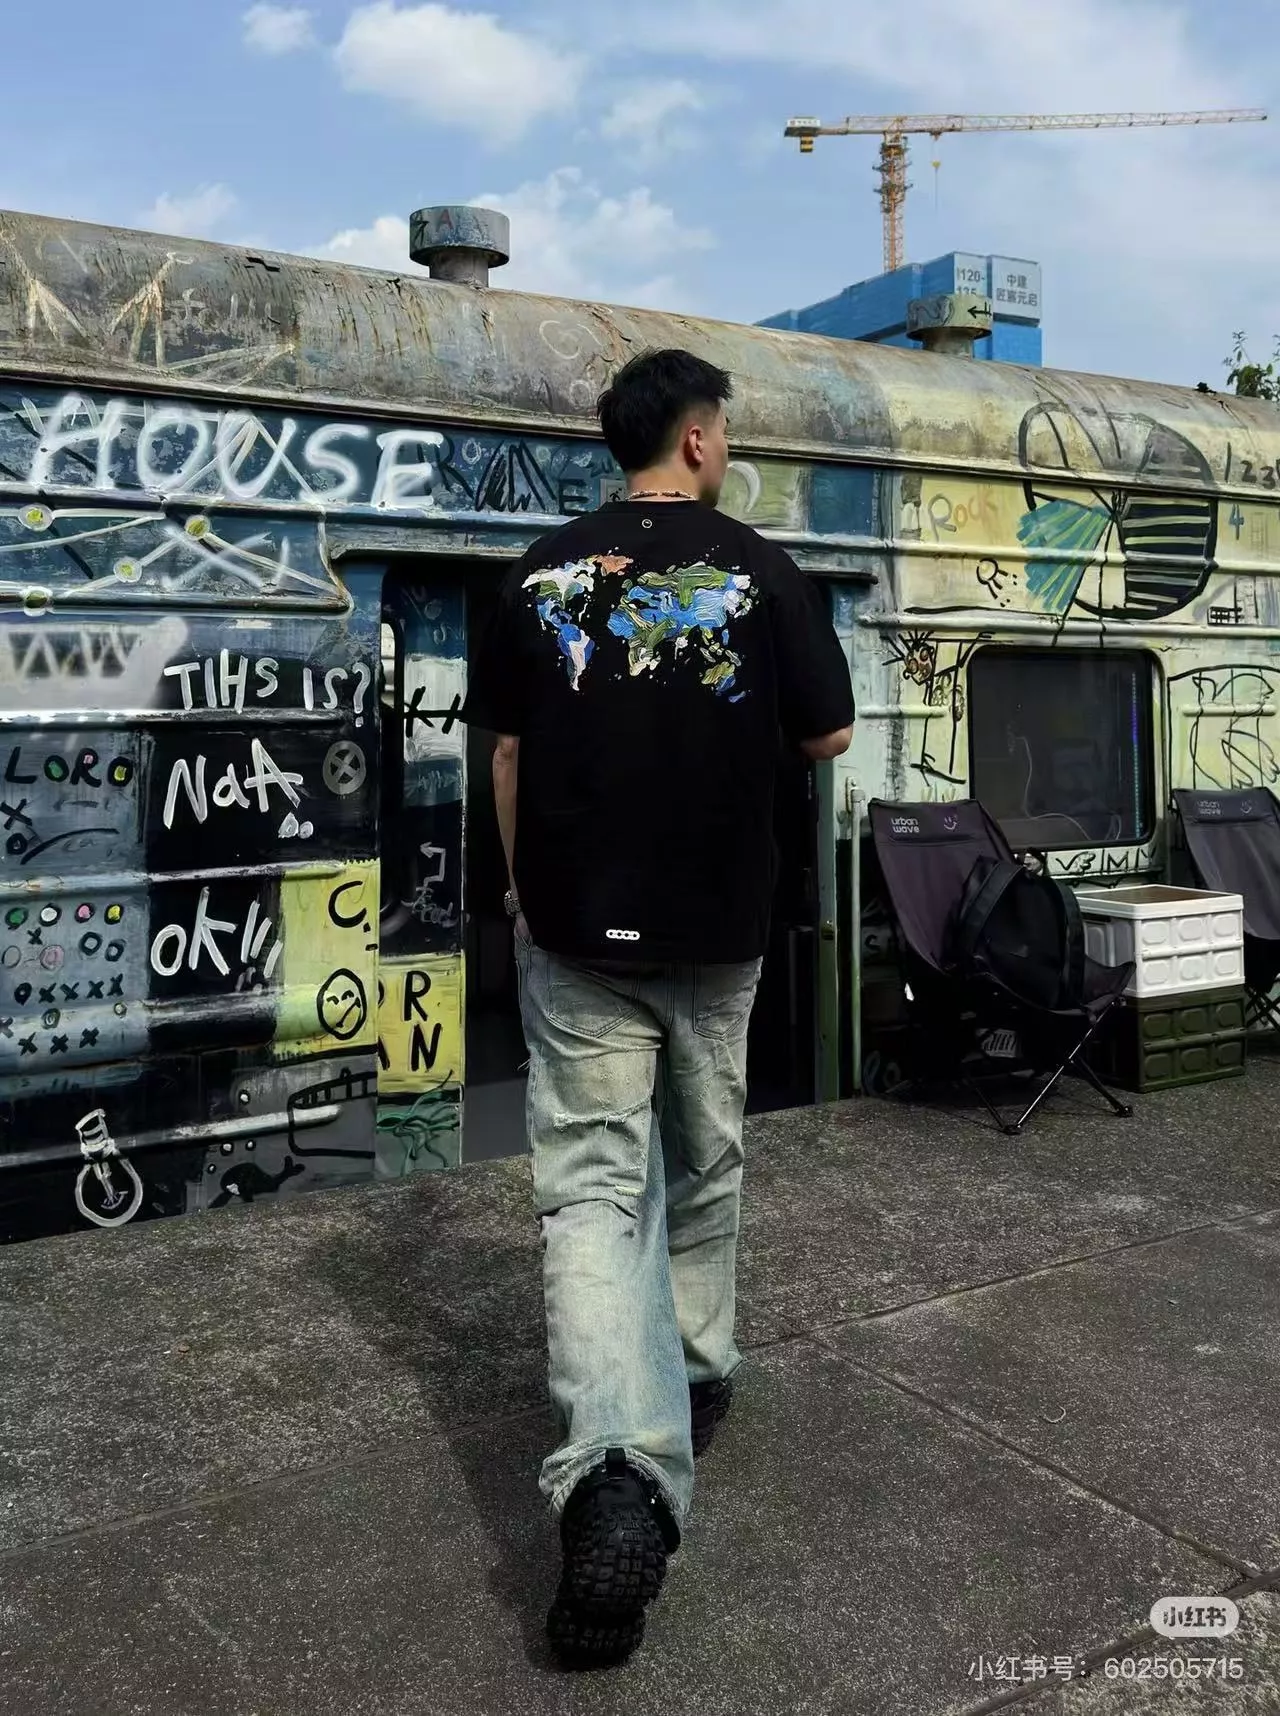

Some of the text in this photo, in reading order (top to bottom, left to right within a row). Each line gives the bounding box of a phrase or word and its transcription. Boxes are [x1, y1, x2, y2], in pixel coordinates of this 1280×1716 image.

[1006, 274, 1027, 288] 中建
[26, 391, 445, 508] HOUSE
[4, 746, 134, 788] LORO
[891, 816, 919, 826] urban
[892, 825, 920, 833] wave
